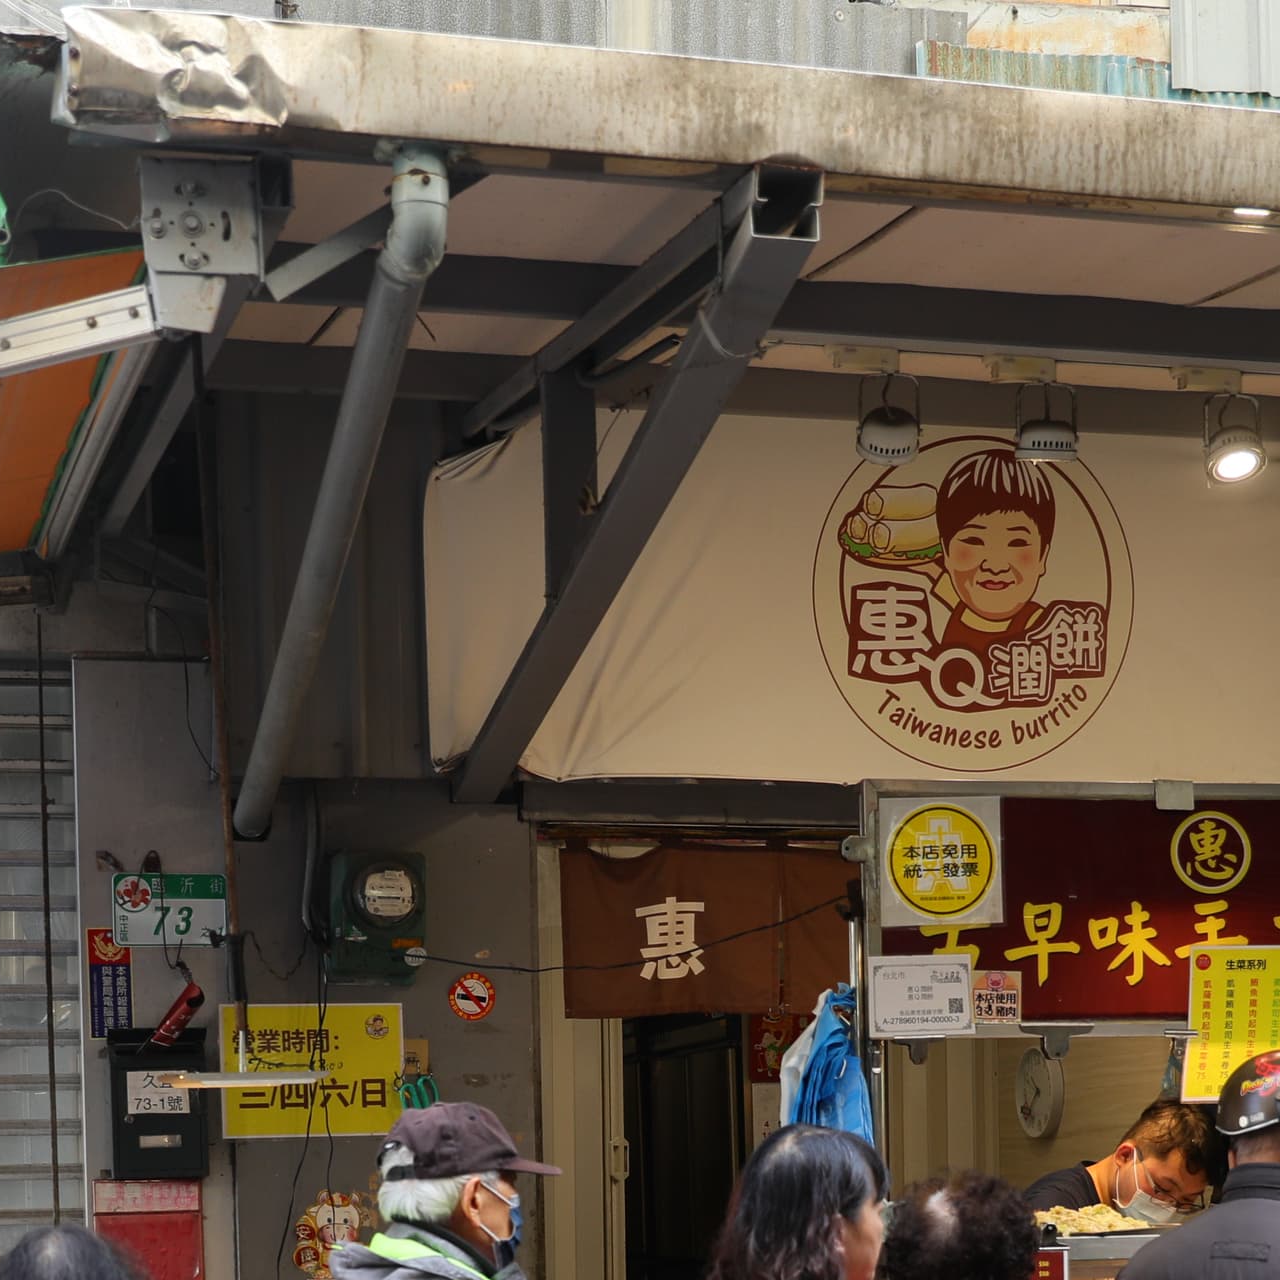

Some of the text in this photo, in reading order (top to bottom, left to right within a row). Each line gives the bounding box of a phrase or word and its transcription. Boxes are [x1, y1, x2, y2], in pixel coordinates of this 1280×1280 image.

[851, 585, 1103, 708] 惠Q潤餅
[876, 683, 1088, 750] Taiwanese burrito
[902, 843, 978, 860] 本店免用
[1187, 820, 1237, 879] 惠
[903, 862, 980, 879] 統一發票
[119, 914, 129, 942] 中正區
[153, 905, 193, 936] 73
[635, 896, 705, 981] 惠
[1225, 958, 1267, 971] 生菜系列
[975, 993, 1017, 1005] 本店使用
[135, 1095, 185, 1112] 73-1號
